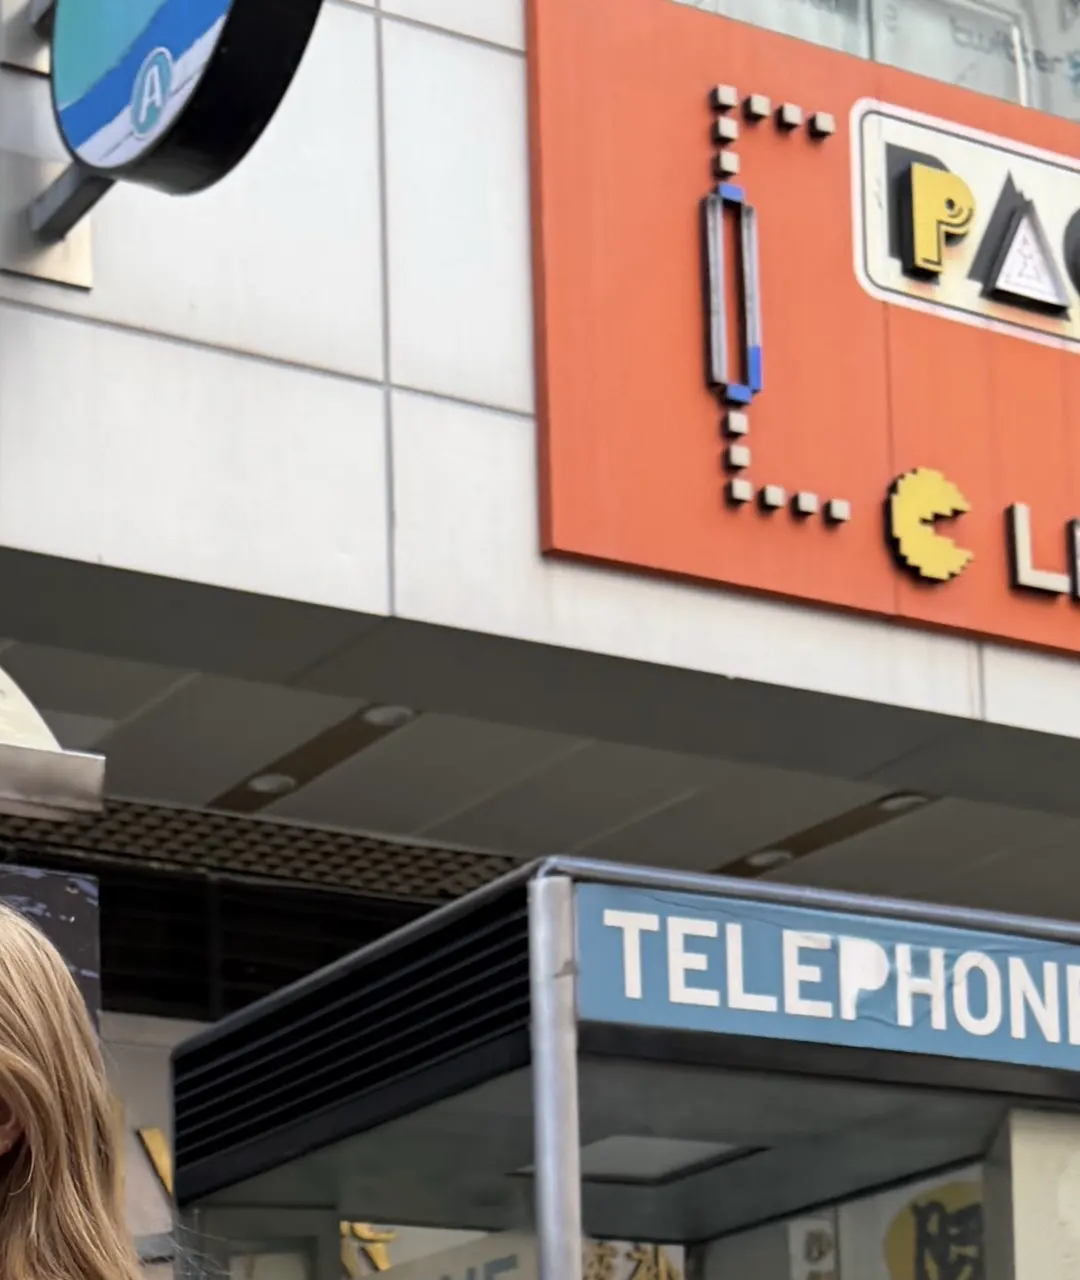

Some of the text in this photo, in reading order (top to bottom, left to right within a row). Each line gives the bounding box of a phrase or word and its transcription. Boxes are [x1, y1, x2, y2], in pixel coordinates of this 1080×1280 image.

[886, 142, 1080, 322] PA
[1003, 502, 1080, 612] L
[603, 908, 1080, 1047] TELEPHON
